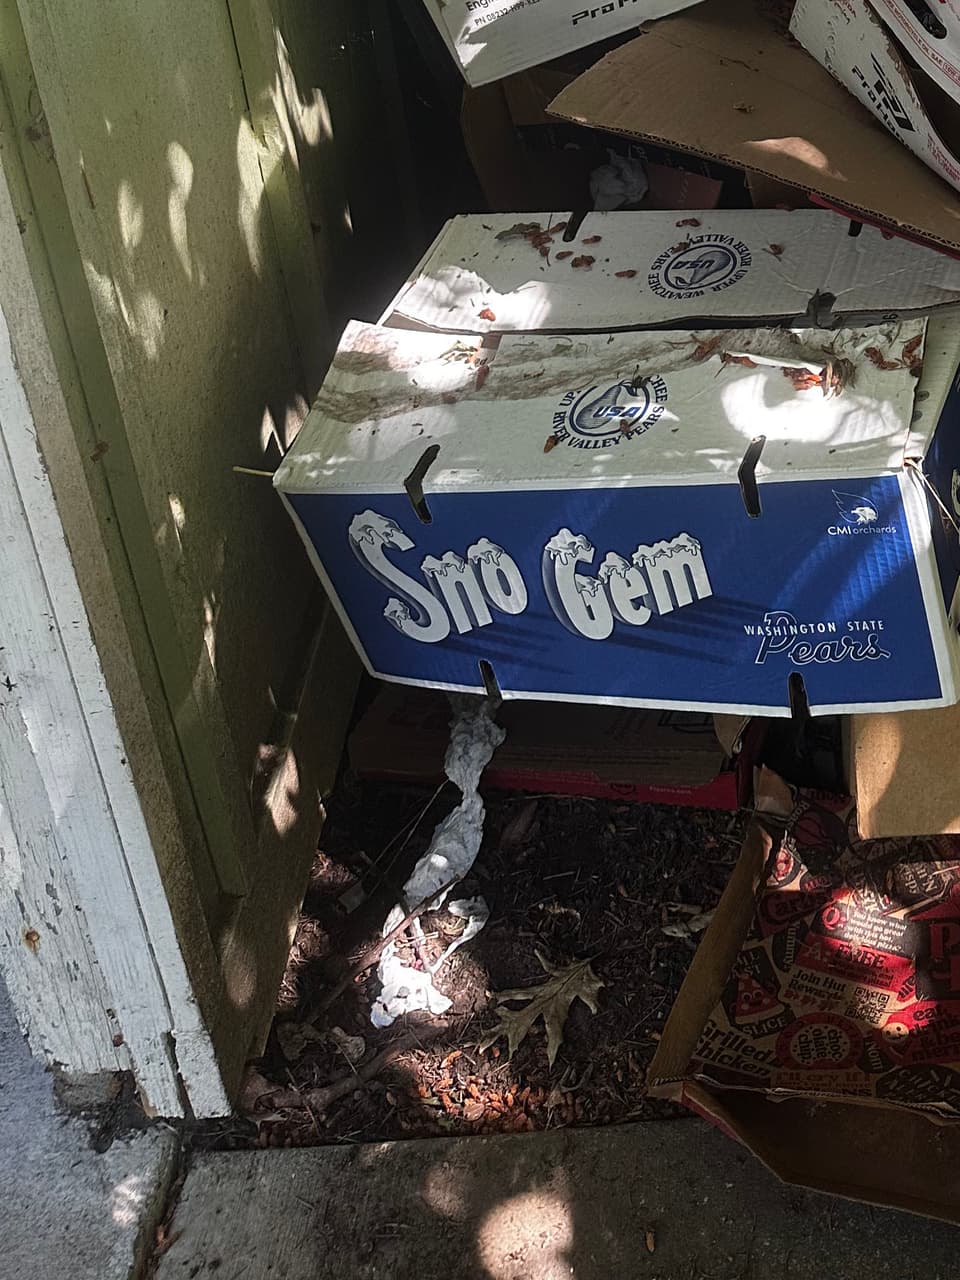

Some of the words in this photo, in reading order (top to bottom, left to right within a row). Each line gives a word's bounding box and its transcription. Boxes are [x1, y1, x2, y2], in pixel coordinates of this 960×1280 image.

[475, 14, 486, 26] PN
[931, 51, 943, 67] SAE
[686, 233, 735, 246] VALLEY
[733, 241, 752, 267] RIVER
[672, 260, 716, 269] USA
[648, 272, 705, 300] WENATCHEE
[593, 407, 641, 417] USA
[553, 411, 571, 442] RIVER
[567, 435, 621, 449] VALLEY
[626, 406, 665, 440] PEARS
[828, 525, 851, 536] CMI
[852, 525, 897, 535] orchards
[349, 509, 528, 643] Sno
[542, 528, 713, 640] Gem
[744, 622, 837, 636] WASHINGTON
[847, 620, 884, 632] STATE
[755, 610, 891, 666] Pears
[884, 927, 904, 937] great
[889, 921, 907, 931] what
[793, 969, 821, 986] Join
[823, 974, 846, 992] Hut
